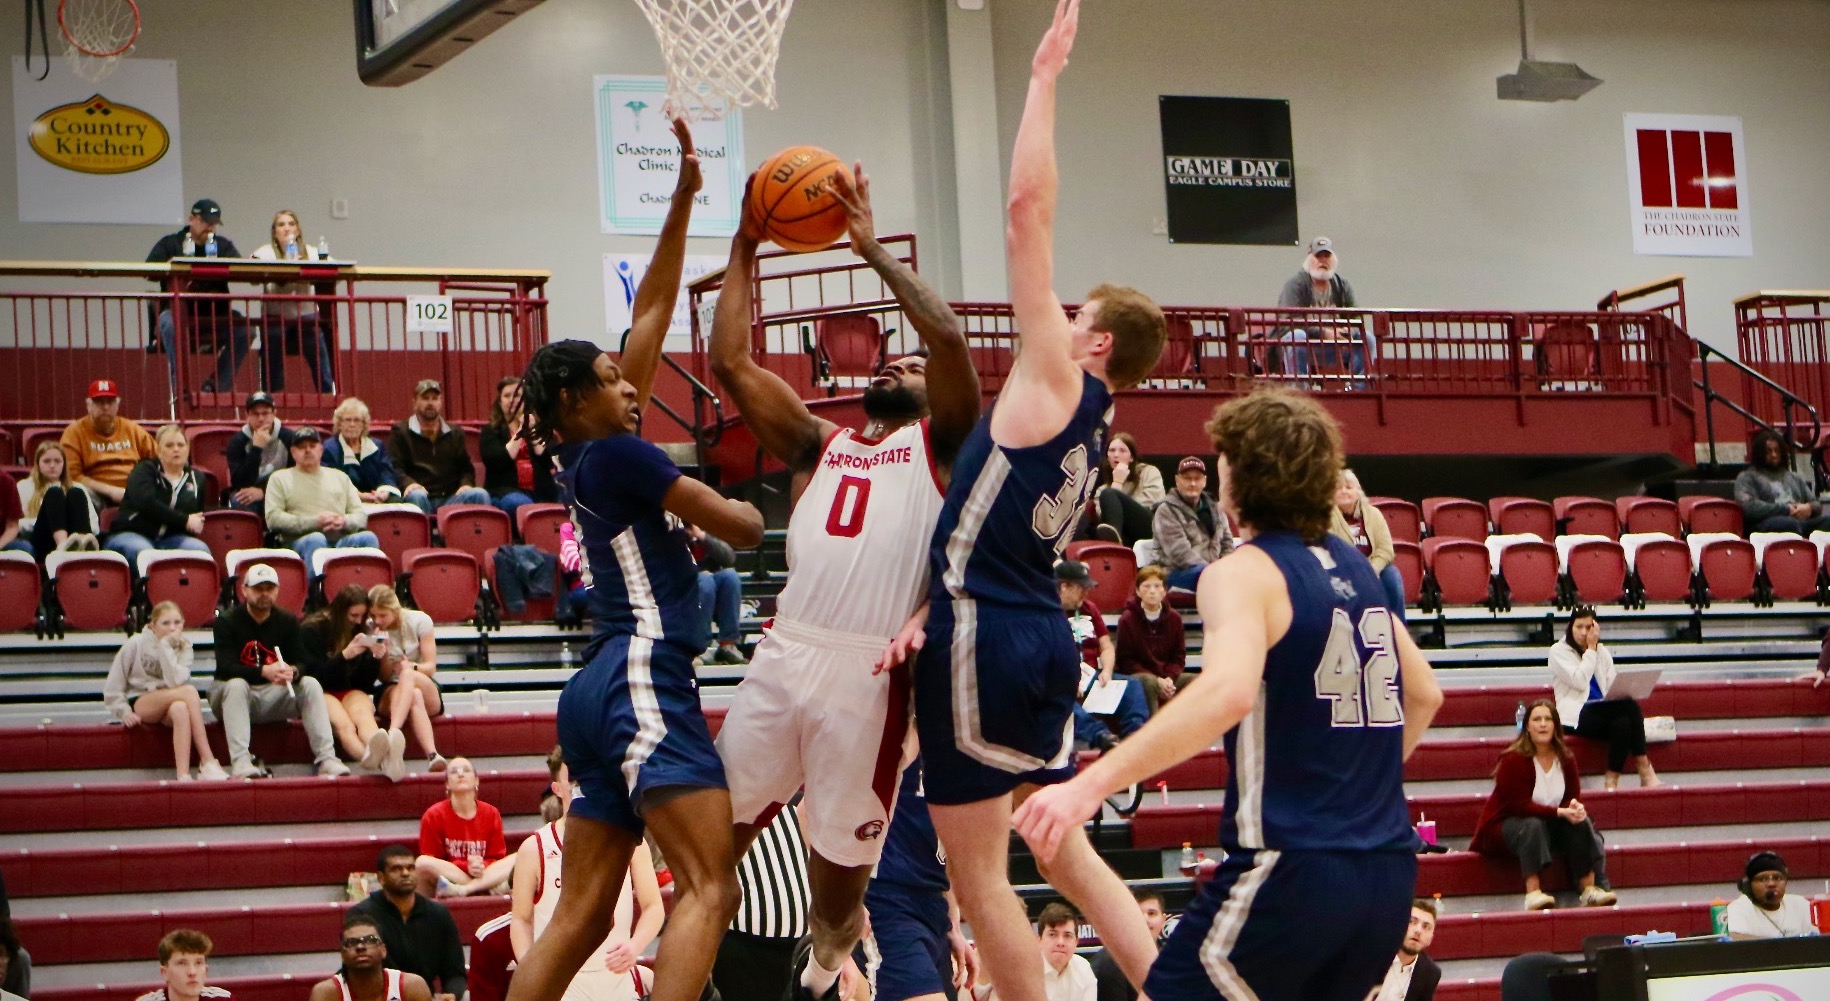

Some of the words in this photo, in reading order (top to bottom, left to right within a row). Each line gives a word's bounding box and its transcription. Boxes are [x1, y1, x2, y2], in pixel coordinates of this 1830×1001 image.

[50, 116, 148, 140] Country
[56, 137, 145, 156] Kitchen
[616, 142, 672, 156] Chadron
[1170, 158, 1230, 177] GAME
[1241, 160, 1280, 178] DAY
[1169, 176, 1206, 186] EAGLE
[1208, 177, 1253, 187] CAMPUS
[1255, 179, 1291, 188] STORE
[1643, 211, 1661, 220] THE
[1664, 212, 1712, 221] CHADRON
[1713, 213, 1737, 222] STATE
[1644, 223, 1740, 237] FOUNDATION
[415, 303, 448, 320] 102
[871, 446, 912, 467] STATE
[825, 474, 872, 538] 0
[1314, 606, 1405, 727] 42
